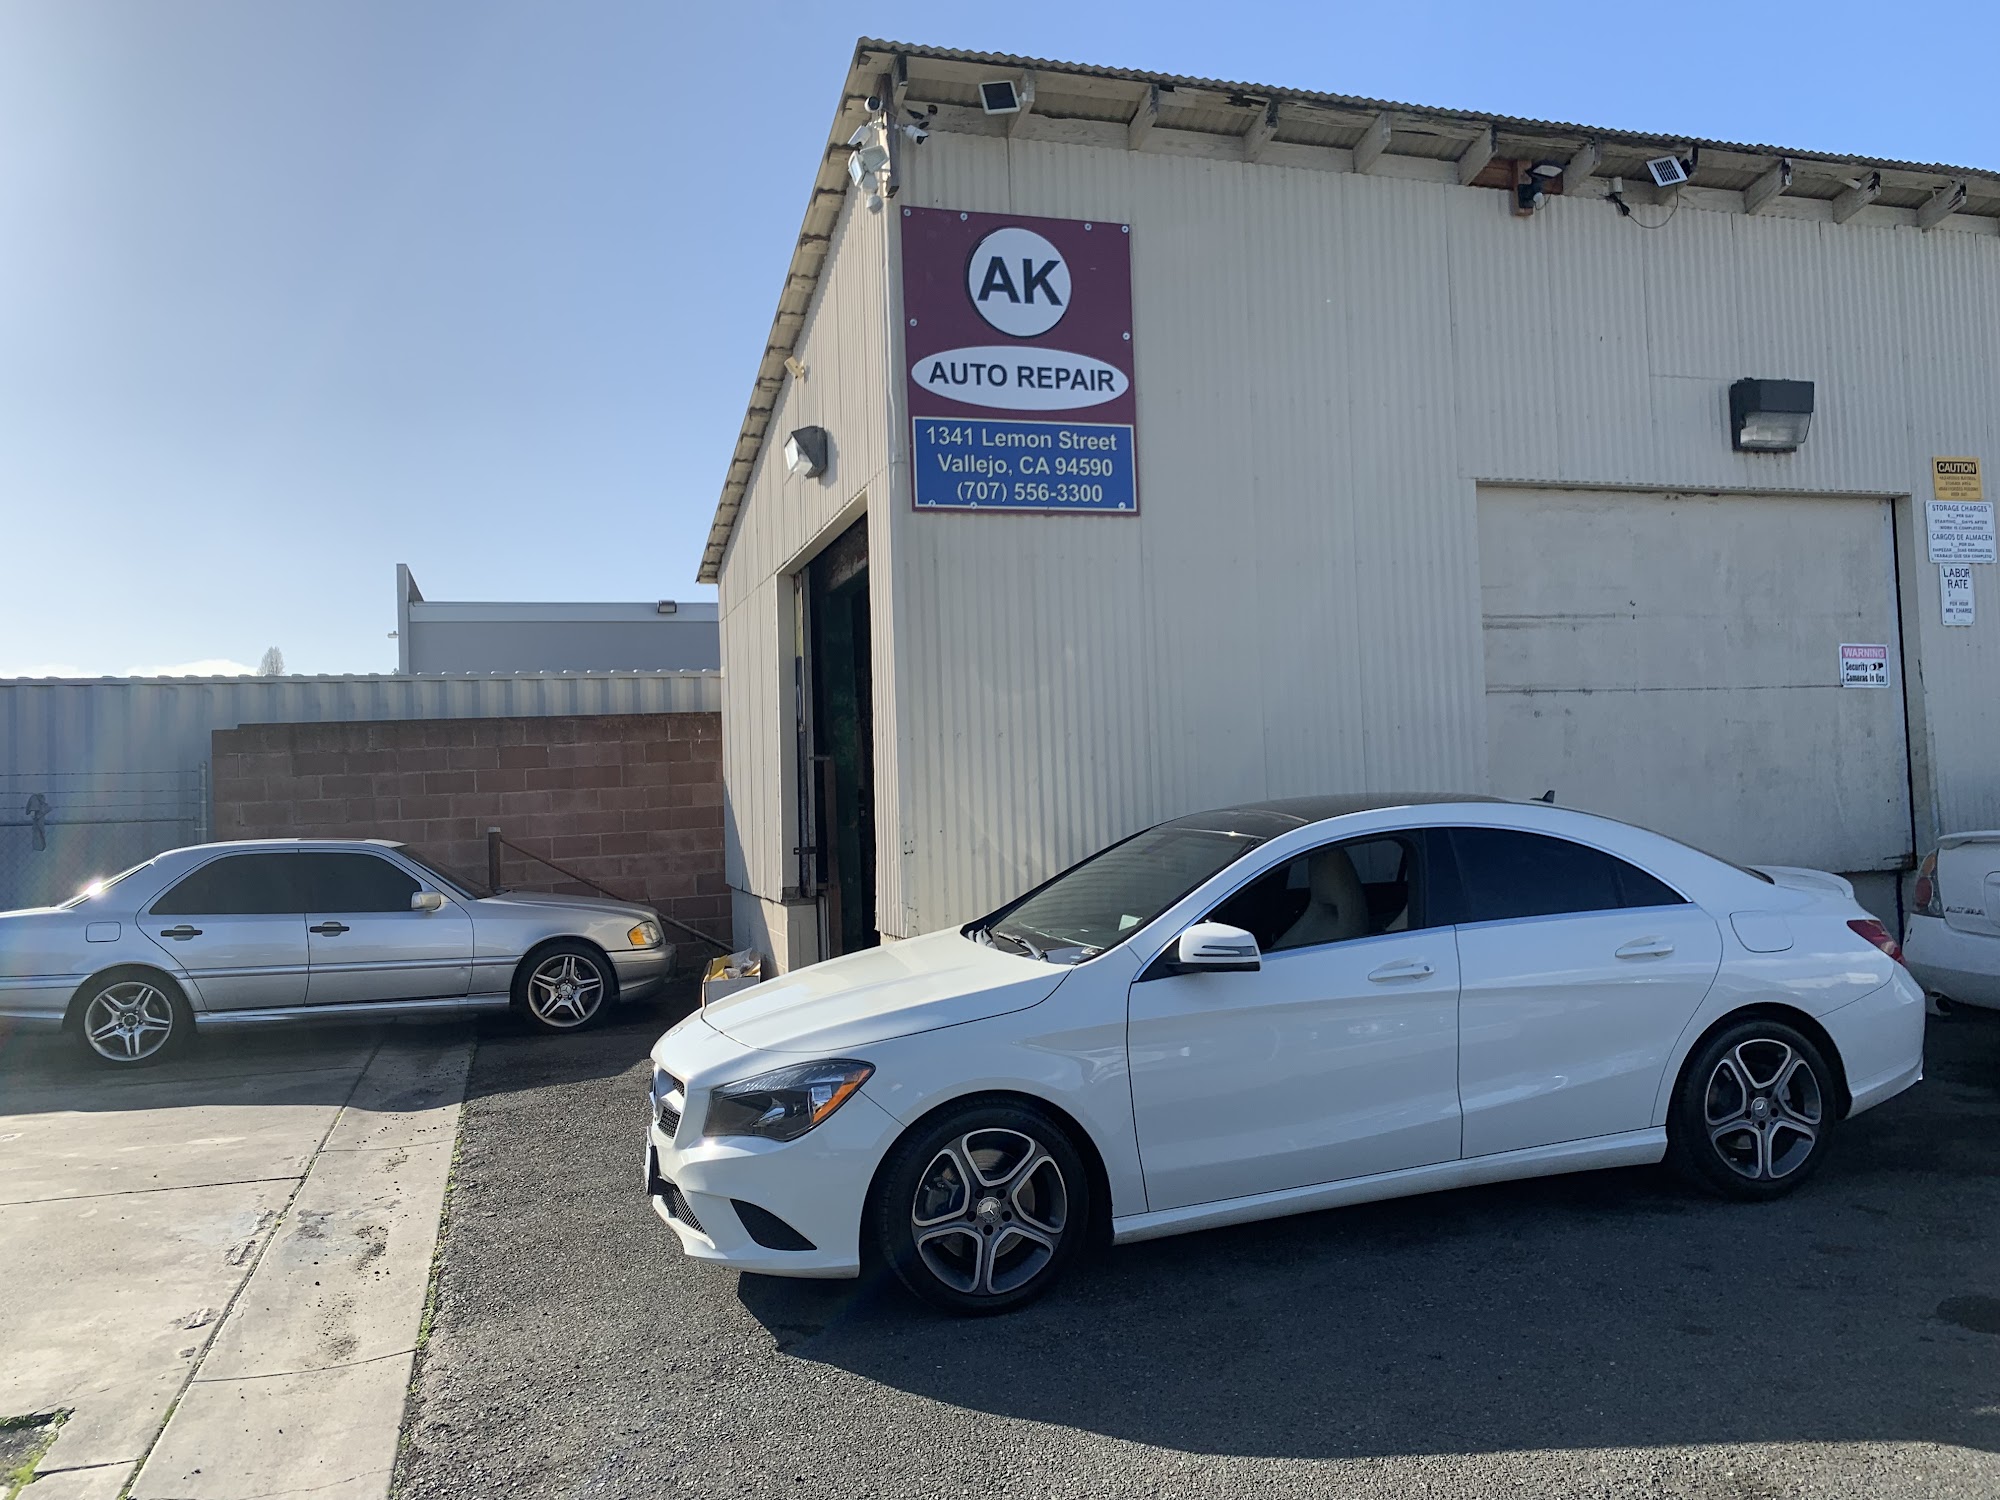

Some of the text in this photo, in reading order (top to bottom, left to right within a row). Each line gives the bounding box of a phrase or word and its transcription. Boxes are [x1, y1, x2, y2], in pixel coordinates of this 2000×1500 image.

[977, 256, 1063, 306] AK
[929, 361, 1116, 393] AUTO REPAIR
[926, 426, 1117, 451] 1341 Lemon Street
[937, 453, 1113, 478] Vallejo, CA 94590
[1938, 462, 1975, 473] CAUTION
[957, 481, 1103, 502] (707) 556-3300
[1932, 504, 1988, 513] STORAGE CHARGES
[1932, 533, 1956, 541] CARGOS
[1943, 568, 1970, 578] LABOR
[1947, 579, 1969, 589] RATE
[1844, 648, 1885, 658] WARNING
[1846, 661, 1868, 673] Security
[1846, 672, 1885, 682] Cameras In Use
